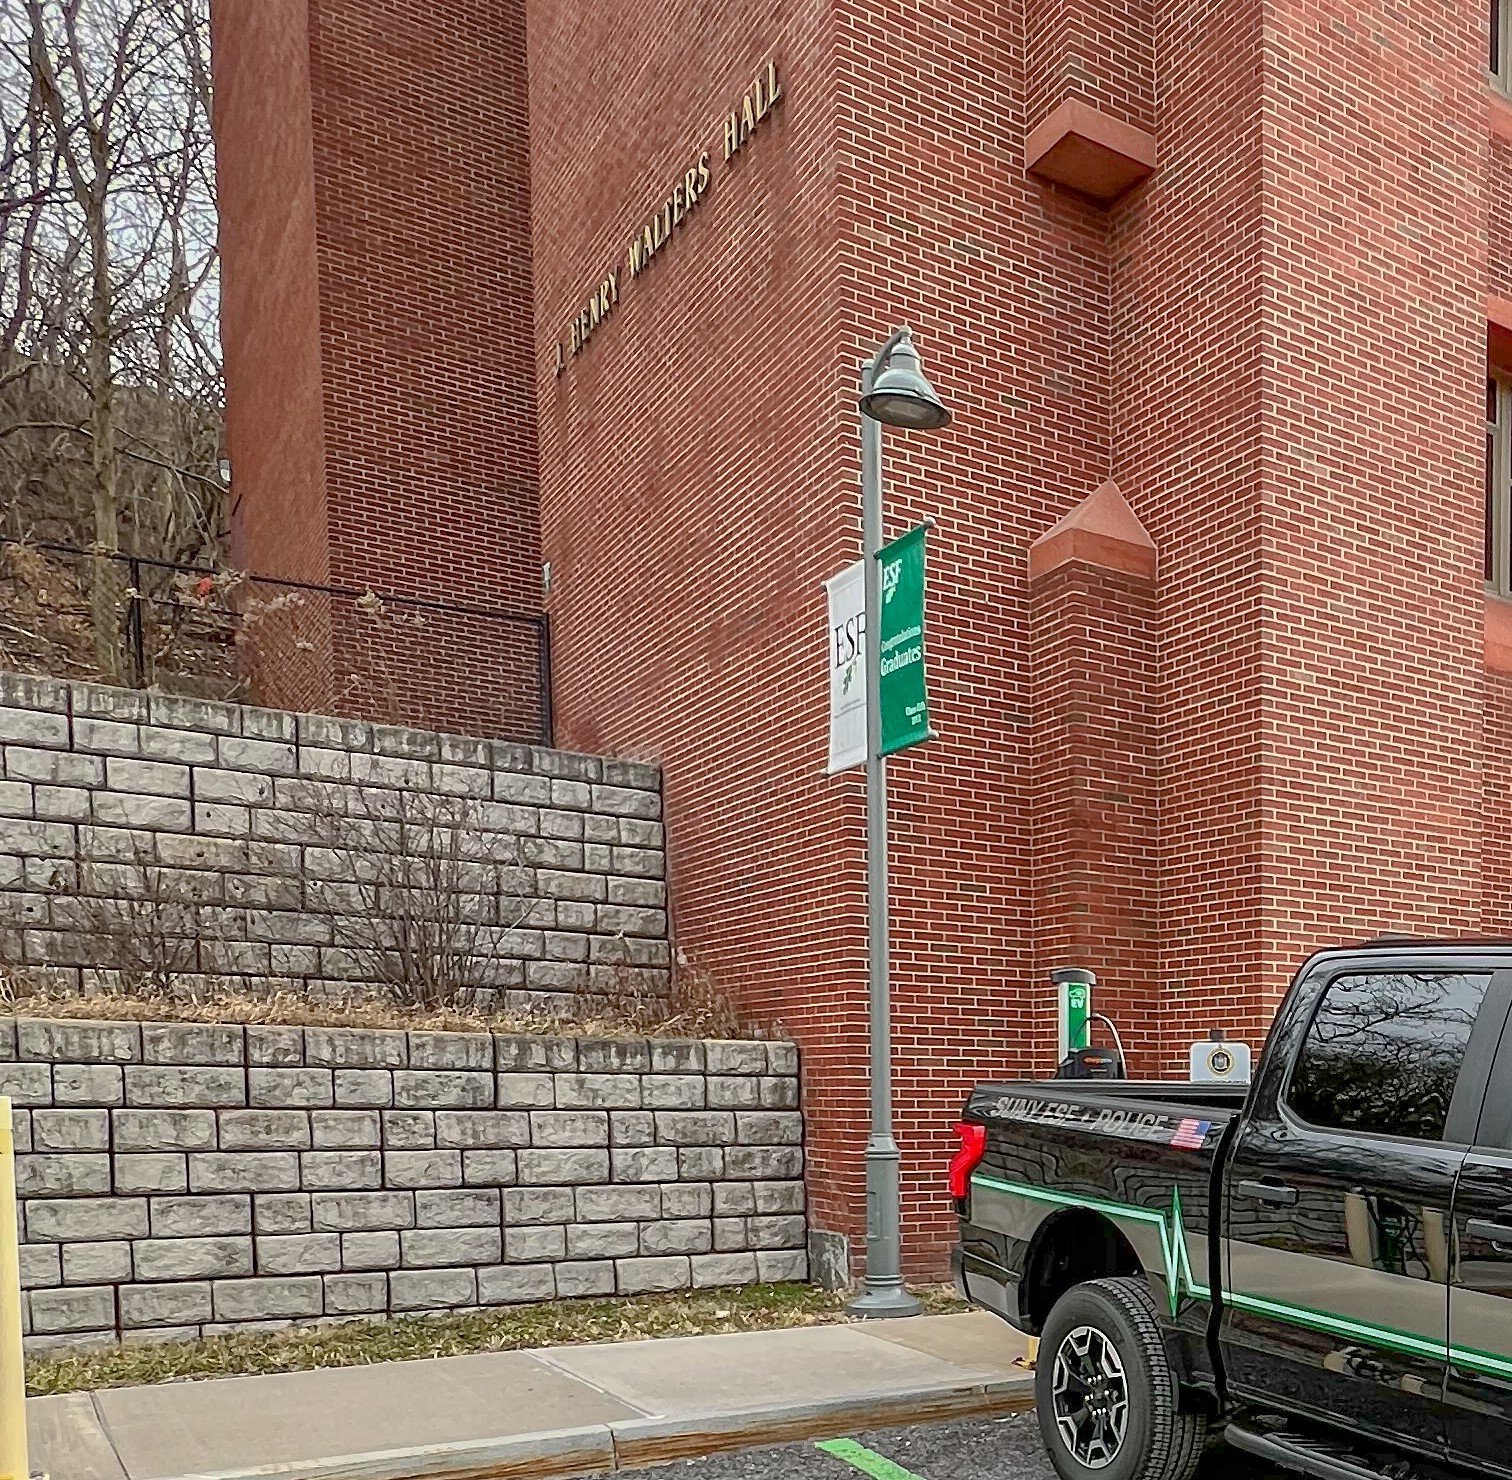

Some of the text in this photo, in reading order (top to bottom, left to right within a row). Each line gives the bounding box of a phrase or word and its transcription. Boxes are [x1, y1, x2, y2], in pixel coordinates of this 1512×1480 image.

[570, 265, 621, 356] HENRY
[628, 151, 710, 280] WALTERS
[724, 59, 781, 162] HALL
[883, 559, 903, 591] ESF
[1089, 1108, 1169, 1139] POLICE
